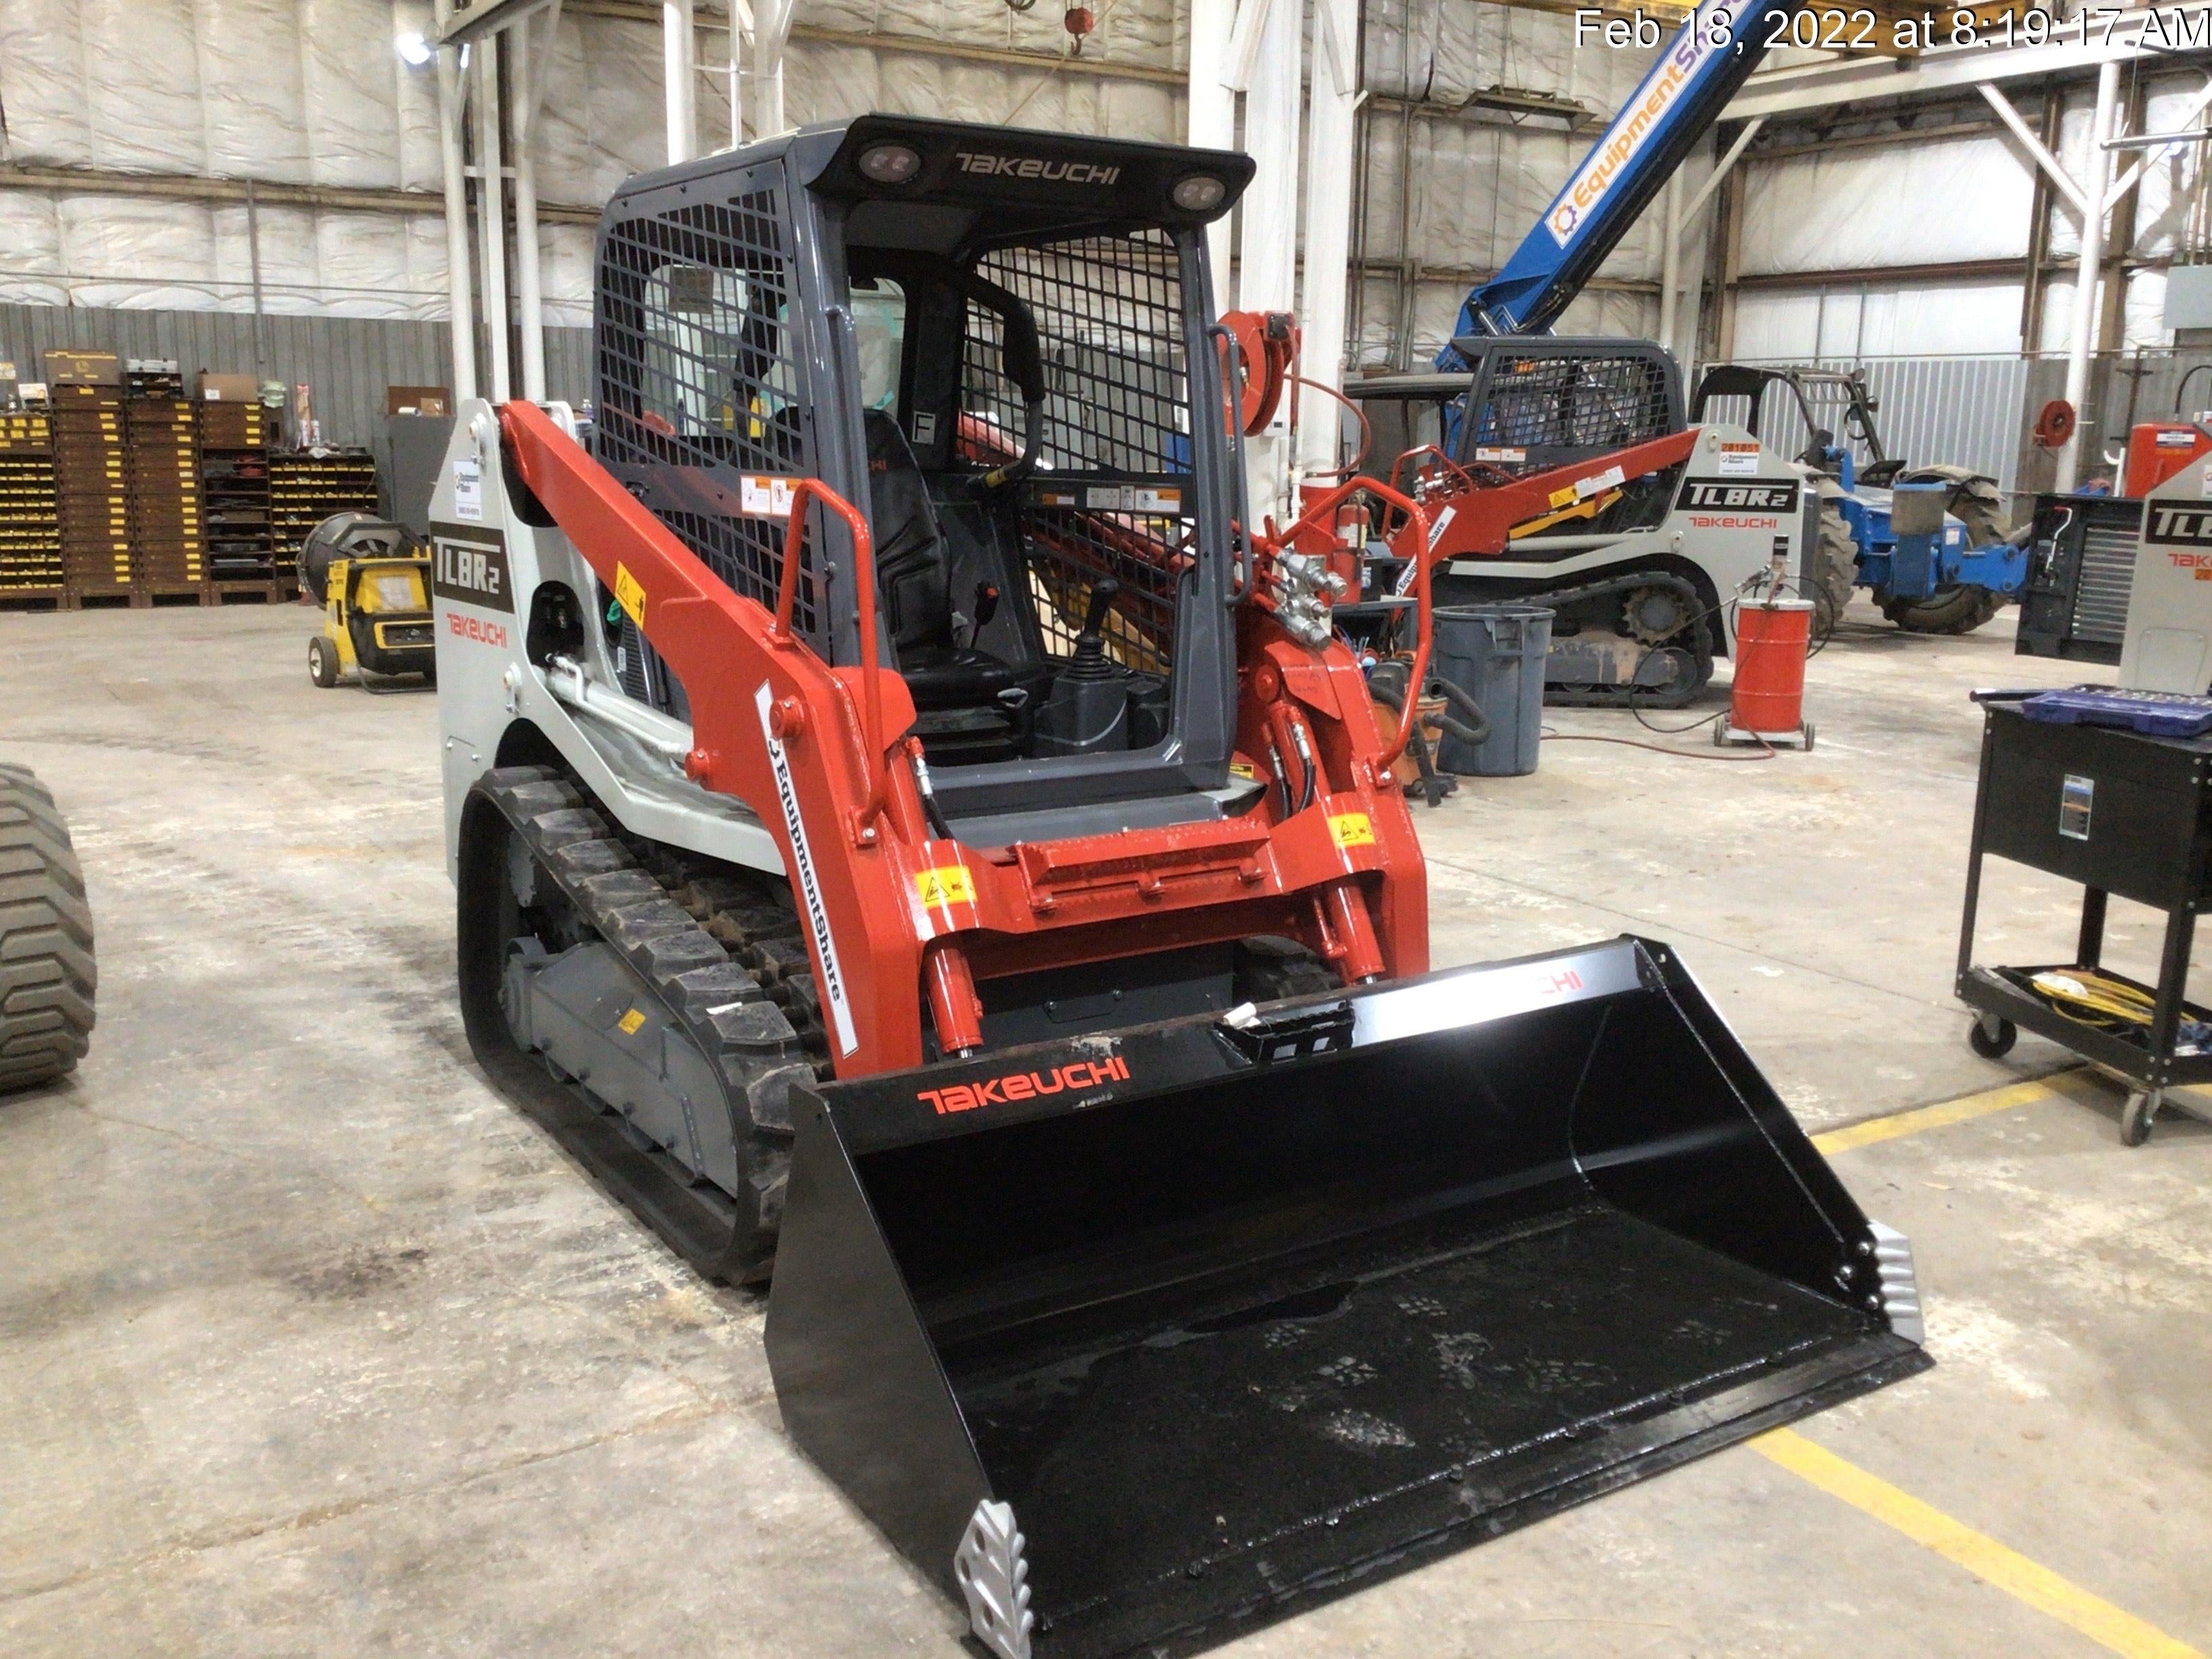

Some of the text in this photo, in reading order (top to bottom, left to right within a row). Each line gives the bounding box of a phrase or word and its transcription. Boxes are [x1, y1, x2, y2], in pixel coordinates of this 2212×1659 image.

[956, 152, 1120, 184] TAKEUCHI
[1689, 517, 1778, 529] TAKEUCHI
[2167, 553, 2212, 567] TAK
[447, 612, 507, 649] TAKEUCHI
[776, 760, 840, 1003] EquipmentShare
[917, 1057, 1130, 1115] TAKEUCHI
